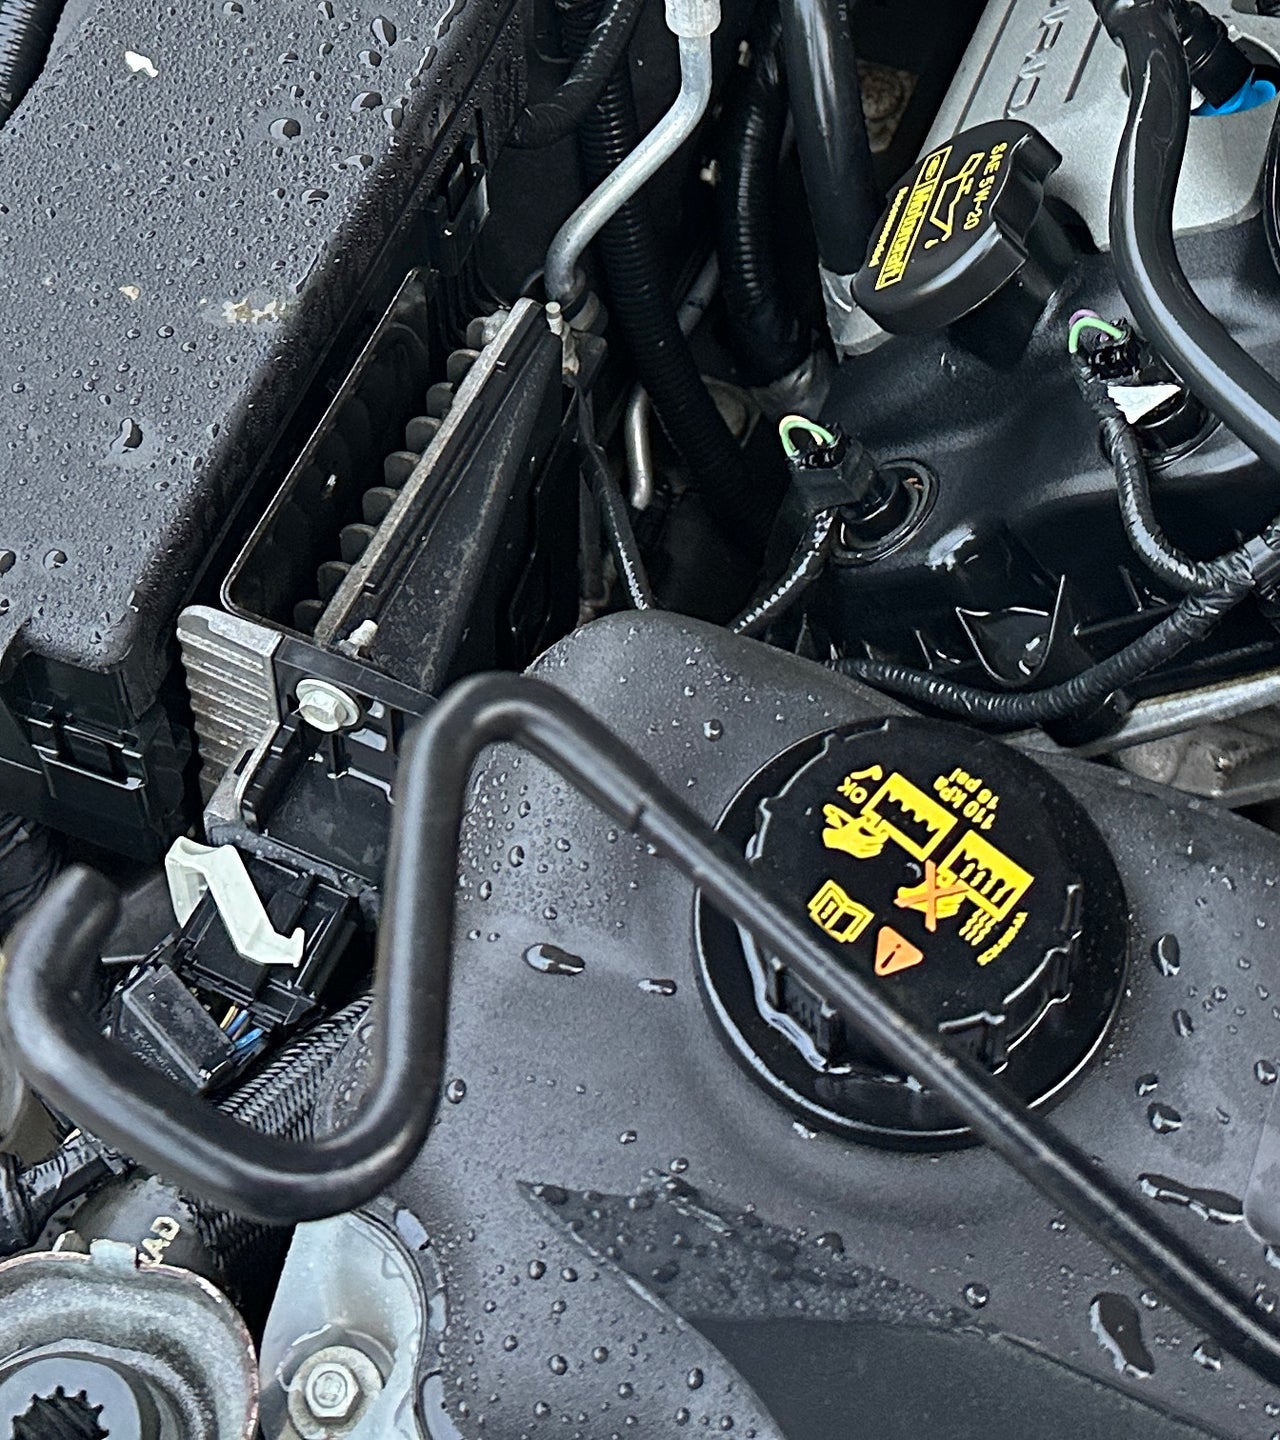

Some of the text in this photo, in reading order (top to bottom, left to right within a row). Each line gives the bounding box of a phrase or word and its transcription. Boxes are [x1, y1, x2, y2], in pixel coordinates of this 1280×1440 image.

[962, 141, 1008, 231] SAE 5W-20
[879, 181, 937, 283] Motorcraft
[836, 775, 868, 804] OK
[932, 774, 996, 830] 110 kPa
[948, 766, 982, 793] psi
